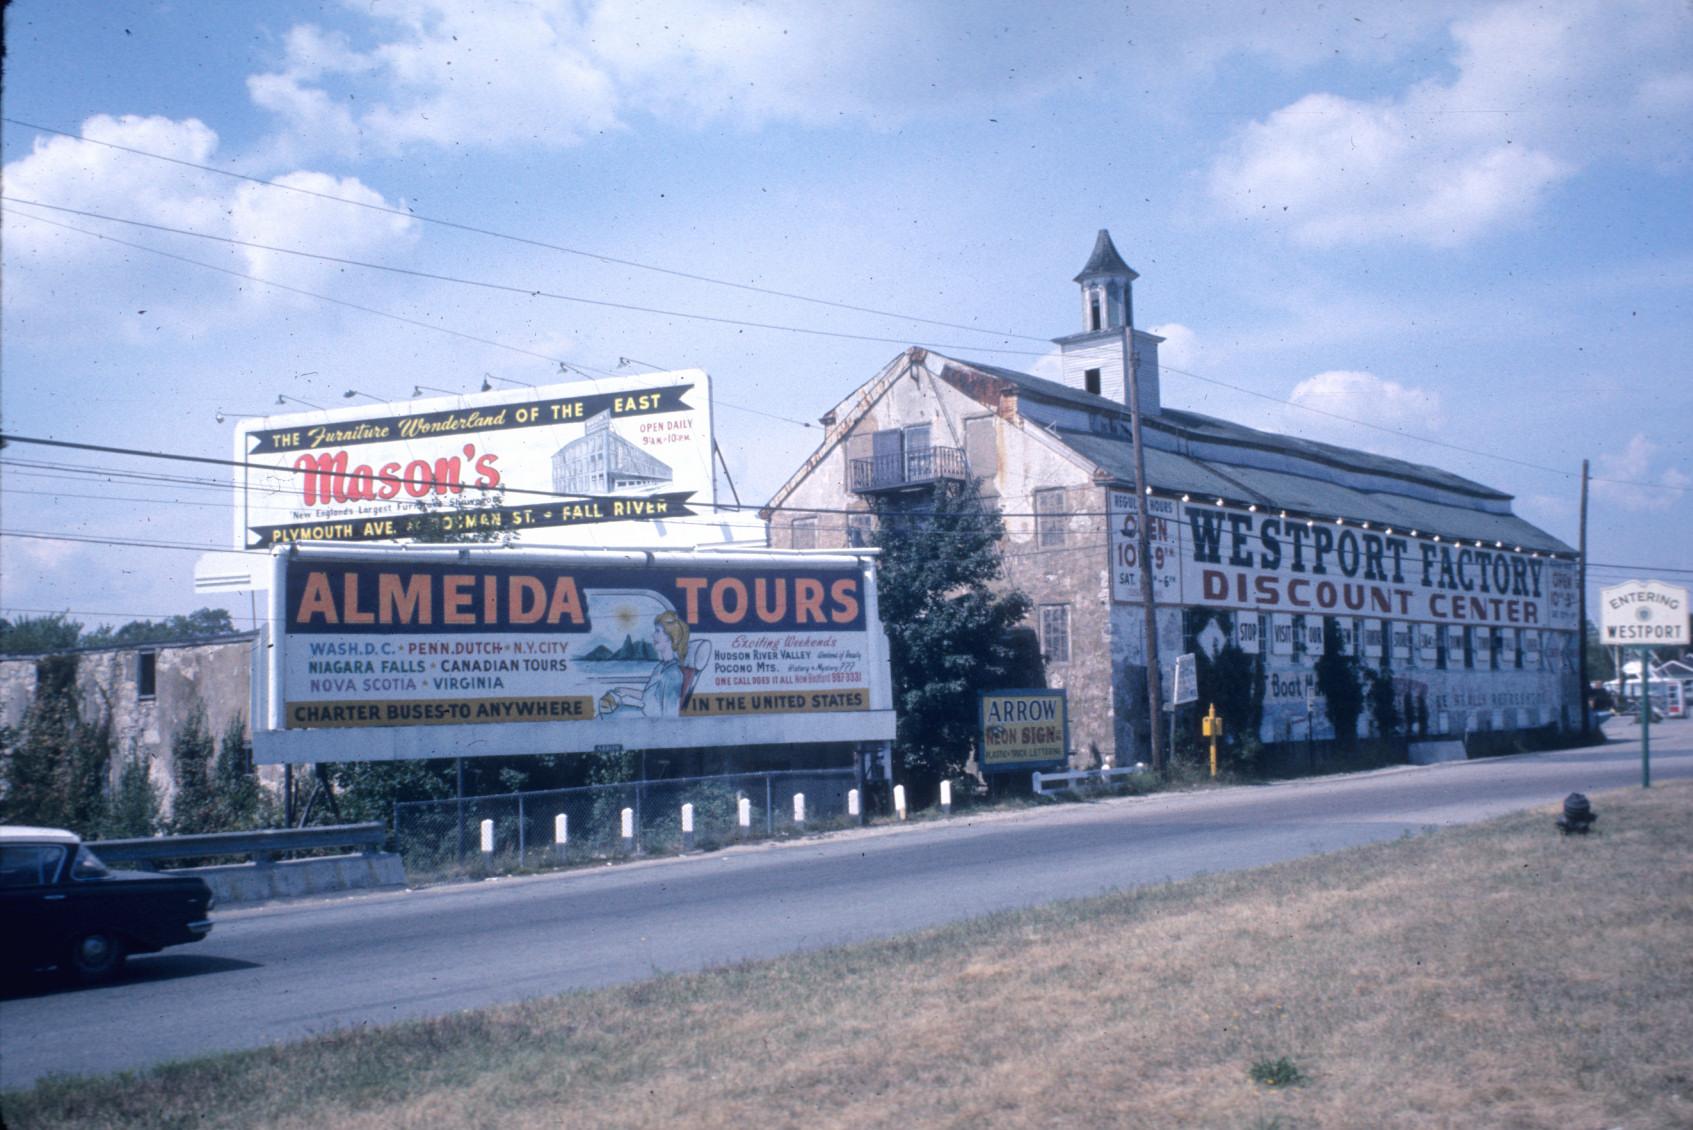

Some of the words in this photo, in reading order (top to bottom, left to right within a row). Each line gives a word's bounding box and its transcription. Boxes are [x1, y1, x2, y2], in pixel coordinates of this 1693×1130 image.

[273, 432, 300, 449] THE
[308, 425, 389, 449] Furniture
[398, 409, 505, 438] Wonderland
[515, 407, 540, 423] OF
[551, 402, 584, 419] THE
[614, 394, 661, 413] EAST
[640, 421, 664, 433] OPEN
[667, 417, 693, 430] DAILY
[293, 443, 501, 507] Mason's
[358, 503, 392, 516] Largest
[272, 523, 354, 543] PLYMOUTH
[363, 520, 397, 537] AVE.
[512, 509, 536, 526] ST.
[562, 503, 604, 520] FALL
[614, 500, 668, 517] RIVER
[1123, 512, 1168, 542] OEN
[1185, 506, 1407, 584] WESTPORT
[1420, 542, 1543, 598] FACTORY
[296, 571, 585, 625] ALMEIDA
[675, 576, 859, 625] TOURS
[1202, 569, 1413, 615] DISCOUNT
[1429, 593, 1539, 624] CENTER
[1608, 591, 1680, 611] ENTERING
[1240, 623, 1257, 641] STOP
[1274, 624, 1292, 643] VISIT
[1308, 626, 1322, 643] OUR
[1607, 624, 1682, 639] WESTPORT
[731, 634, 781, 651] Exciting
[784, 635, 837, 648] Weekends
[714, 649, 751, 661] HUDSON
[753, 649, 778, 661] RIVER
[780, 649, 811, 661] VALLEY
[308, 660, 375, 674] NIAGARA
[381, 660, 426, 673] FALLS
[440, 659, 519, 673] CANADIAN
[524, 658, 568, 672] TOURS
[714, 662, 752, 673] POCONO
[310, 678, 356, 693] NOVA
[363, 678, 417, 691] SCOTIA
[433, 677, 504, 690] VIRGINIA
[714, 677, 731, 687] ONE
[733, 676, 751, 686] CALL
[772, 675, 778, 685] IT
[780, 675, 793, 685] ALL
[1271, 672, 1302, 698] Boat
[294, 703, 381, 722] CHARTER
[476, 699, 583, 718] ANYWHERE
[692, 698, 710, 712] IN
[716, 696, 747, 711] THE
[752, 694, 804, 710] UNITED
[812, 692, 862, 708] STATES
[988, 699, 1057, 722] ARROW
